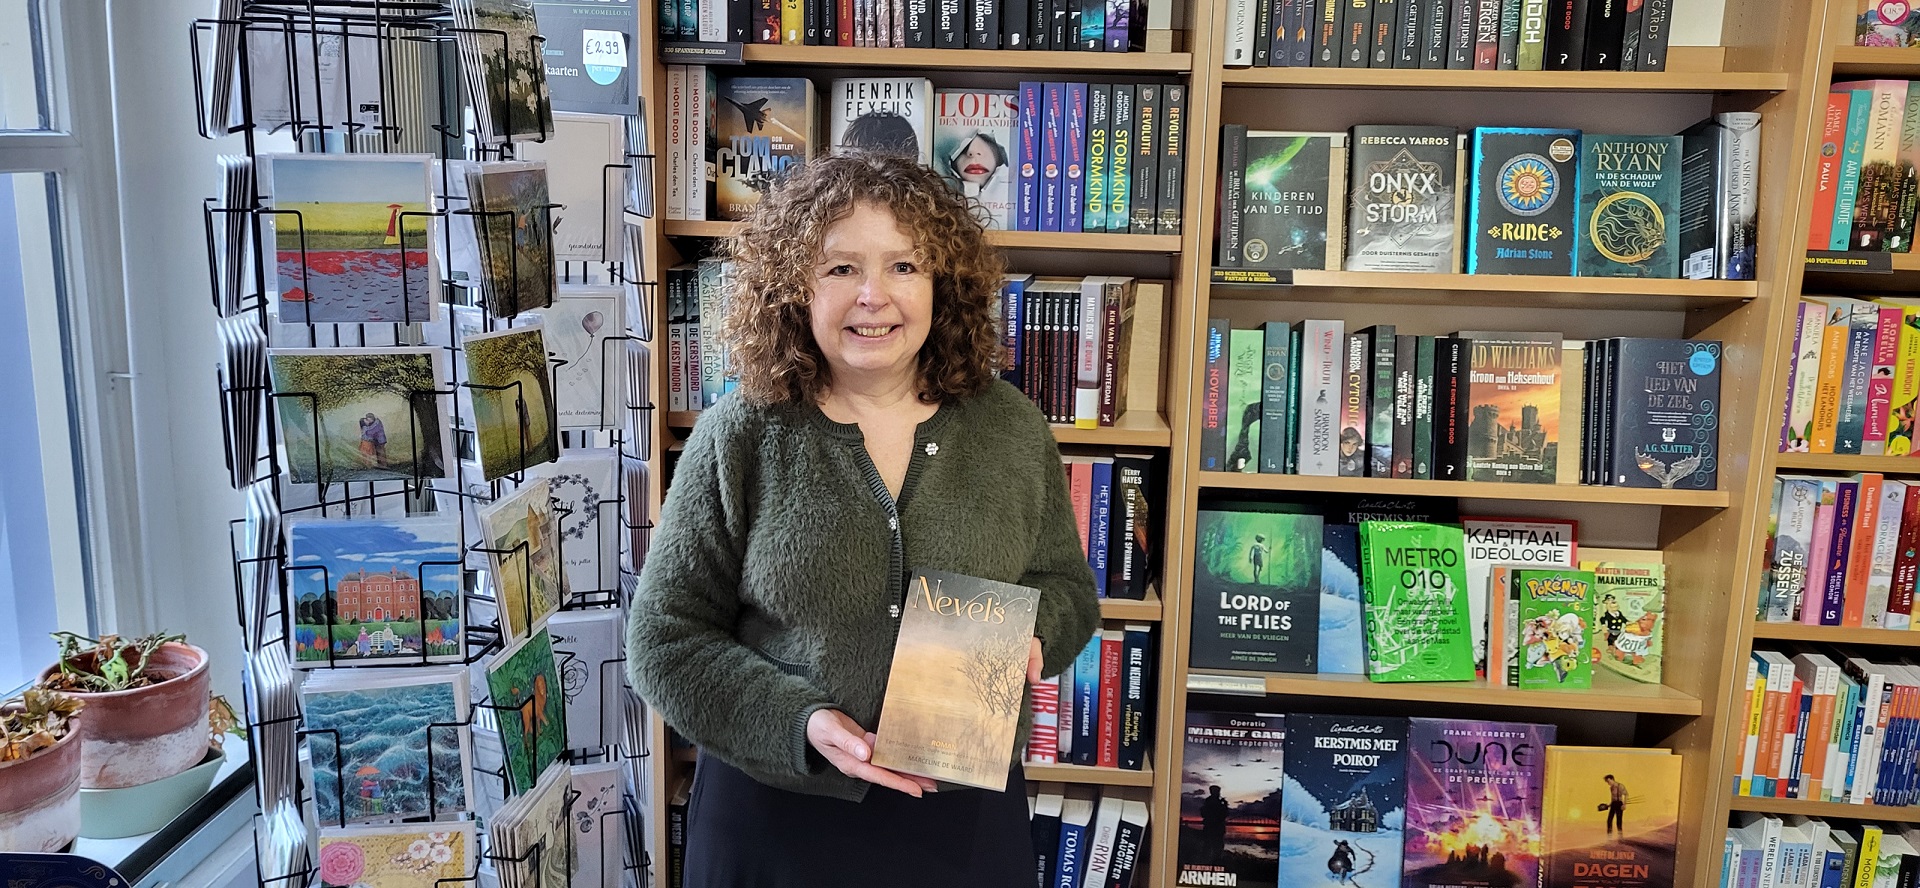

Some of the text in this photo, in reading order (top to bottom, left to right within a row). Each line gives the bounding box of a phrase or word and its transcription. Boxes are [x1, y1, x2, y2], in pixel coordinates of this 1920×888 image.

[572, 8, 632, 17] WWW.COMELLO.NL
[1406, 5, 1418, 48] GETIJDEN
[1433, 5, 1444, 48] GETIJDEN
[1648, 1, 1661, 40] CARDS
[586, 38, 620, 55] €2.99
[545, 63, 579, 77] kaarten
[846, 83, 915, 101] HENRIK
[938, 92, 1019, 118] LOES
[845, 101, 913, 118] FEXEUS
[1824, 103, 1835, 137] ALLENDE
[1832, 109, 1842, 134] ISABEL
[1873, 93, 1891, 150] BOMANN
[1140, 107, 1153, 156] REVOLUTIE
[1167, 107, 1180, 156] REVOLUTIE
[1361, 136, 1450, 146] REBECCA YARROS
[729, 135, 771, 157] TOM
[1591, 142, 1669, 154] ANTHONY
[1089, 129, 1105, 213] STORMKIND
[1112, 129, 1128, 214] STORMKIND
[1595, 172, 1662, 181] IN DE SCHADUW
[1597, 153, 1662, 172] RYAN
[1819, 162, 1832, 191] PAULA
[1251, 191, 1315, 202] KINDEREN
[1369, 172, 1437, 195] ONYX
[1633, 180, 1657, 188] WOLF
[1837, 160, 1858, 224] AAN HET LIJNTJE
[1858, 164, 1875, 228] SOPHIA'S WENS
[1244, 205, 1323, 215] VAN DE TIJD
[1366, 203, 1437, 224] STORM
[1502, 222, 1549, 241] RUNE
[1495, 247, 1553, 259] Adrian Stone
[1085, 297, 1095, 372] MATHIJS DEEN DE DUIKER
[1877, 318, 1891, 363] KINSELLA
[1886, 323, 1897, 358] SOPHIE
[671, 328, 681, 393] DE KERSTMOORD
[689, 328, 700, 391] DE KERSTMOORD
[1104, 310, 1116, 405] KIKI VAN DIJK AMSTERDAM
[1491, 347, 1555, 370] WILLIAMS
[1656, 361, 1686, 376] HET
[1855, 331, 1870, 396] ANNE JACOBS
[1507, 371, 1555, 386] Heksenhout
[1844, 331, 1862, 423] DE BELOFTE VAN HET WEESMEISJE
[1902, 358, 1915, 397] VERKNOCHT
[1207, 368, 1219, 428] NOVEMBER
[1346, 374, 1361, 427] CYTONIC
[1817, 382, 1829, 431] HET LANDHUIS
[1826, 386, 1837, 428] HOOP VOOR
[1312, 408, 1322, 455] SANDERSON
[1321, 413, 1330, 451] BRANDON
[1644, 444, 1693, 454] A.G. SLATTER
[1861, 487, 1875, 528] Danielle Steel
[1097, 485, 1109, 569] HET BLAUWE UUR
[1123, 488, 1135, 581] HET JAAR VAN DE SPRINKHAAN
[1467, 528, 1568, 547] KAPITAAL
[1385, 547, 1457, 568] METRO
[1471, 547, 1564, 562] IDEOLOGIE
[1873, 515, 1889, 575] STORMGLOED
[1400, 570, 1446, 589] 010
[1597, 576, 1658, 587] MAANBLAFFERS
[1775, 550, 1793, 598] ZUSSEN
[1789, 553, 1804, 597] DE ZEVEN
[913, 575, 1008, 625] Nevels
[1220, 591, 1291, 611] LORD OF
[1218, 613, 1292, 631] THE FLIES
[1111, 651, 1119, 677] FREIDA
[1128, 647, 1143, 699] NELE NEUHAUS
[1106, 687, 1114, 698] DE
[1082, 682, 1091, 736] HET APPELMEISJE
[1230, 718, 1266, 727] Operatie
[1123, 704, 1133, 747] vriendschap
[1127, 711, 1142, 741] Eeuwige
[1443, 729, 1525, 739] FRANK HERBERT'S
[1833, 718, 1842, 743] rotterdam
[1844, 720, 1853, 740] valencia
[1187, 736, 1285, 748] Nederland, september
[1314, 736, 1399, 752] KERSTMIS MET
[907, 755, 941, 768] MARCELINE
[942, 761, 950, 769] DE
[951, 763, 973, 773] WAARD
[1333, 753, 1380, 767] POIROT
[1449, 775, 1515, 785] DE PROFEET
[1062, 830, 1078, 873] TOMAS
[1091, 844, 1109, 873] RYAN
[1111, 828, 1131, 879] SLAUGHTER
[1122, 842, 1136, 870] KARIN
[1765, 836, 1777, 871] WERELDS
[1841, 848, 1853, 882] DE PADEN
[1179, 870, 1237, 887] ARNHEM
[1573, 862, 1648, 879] DAGEN
